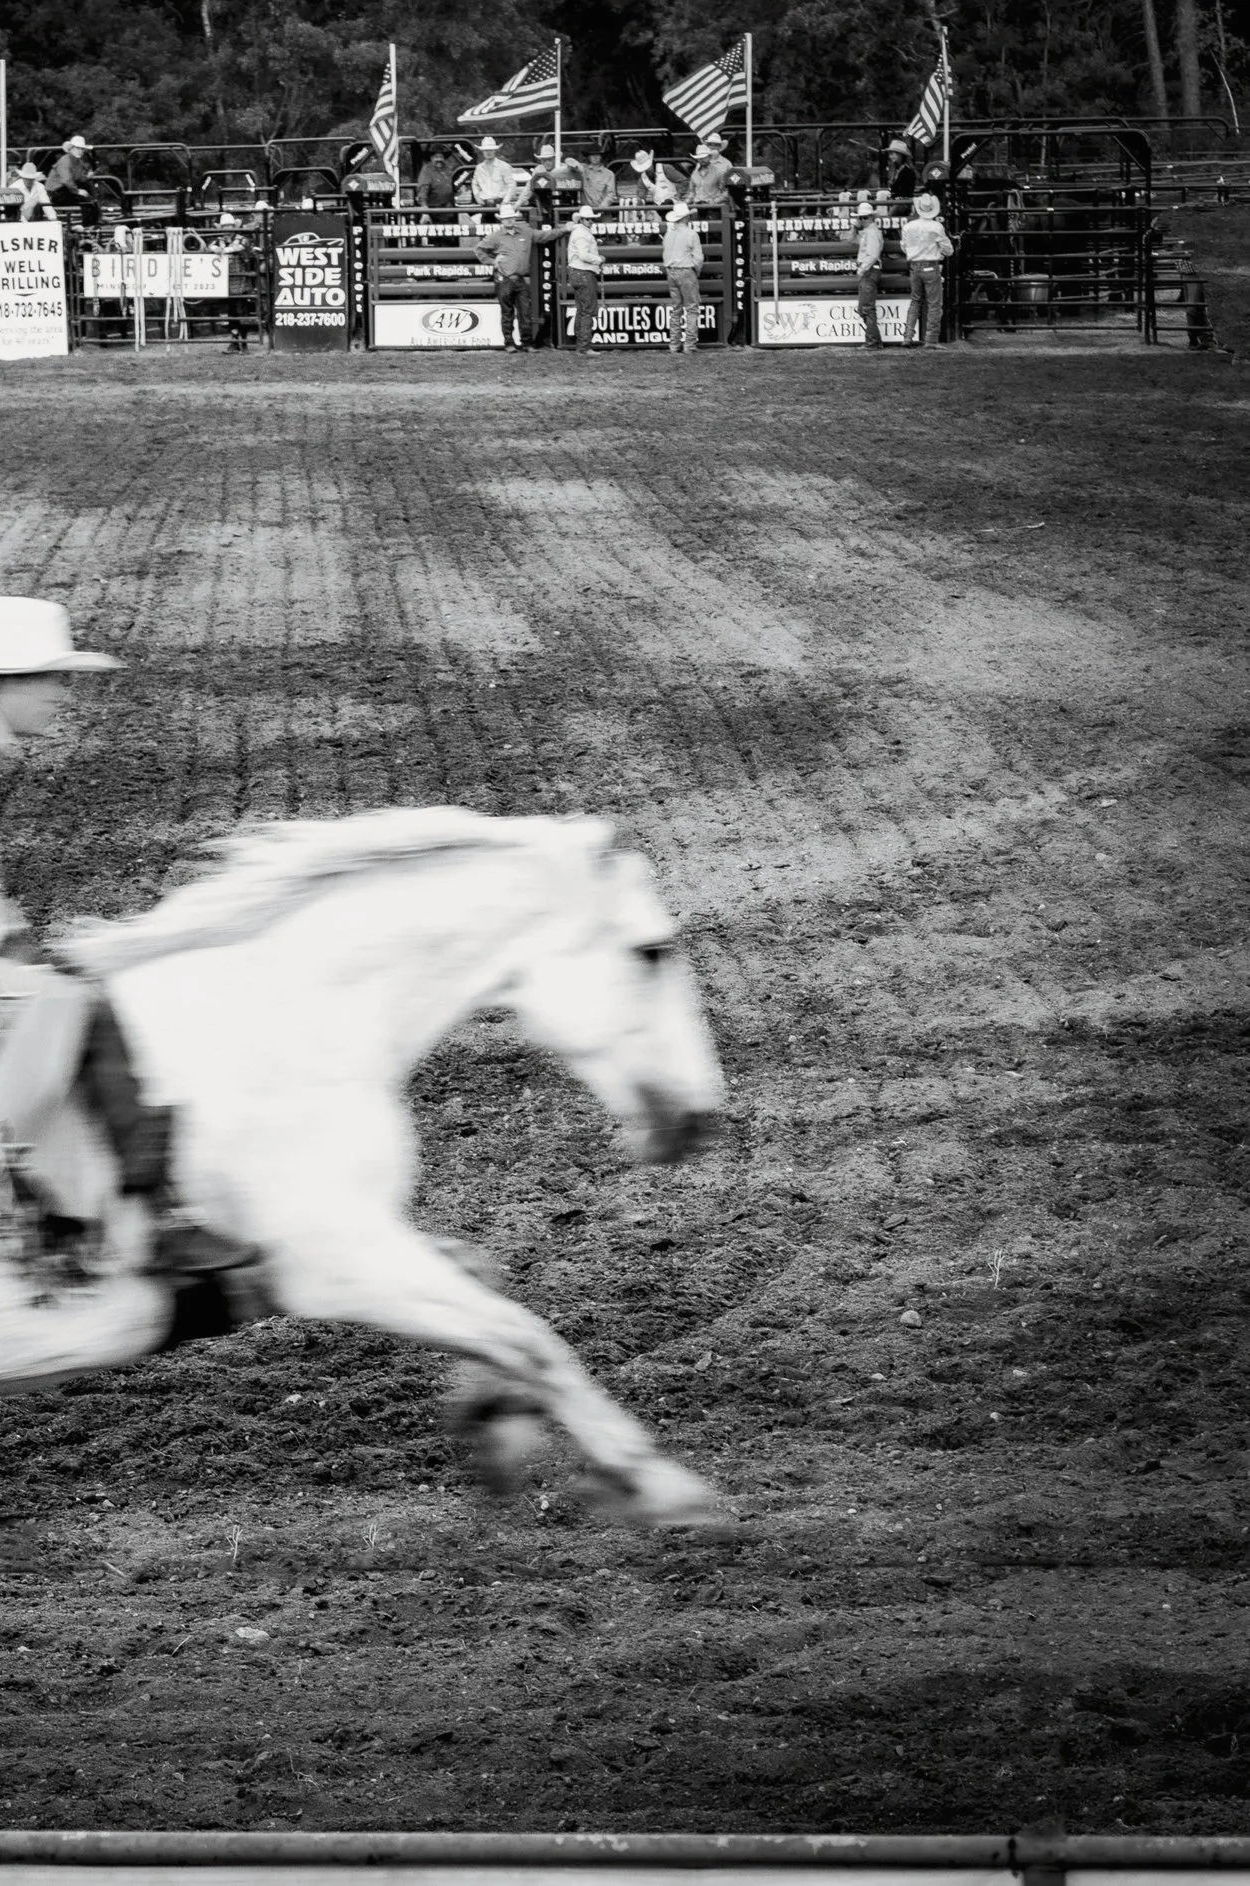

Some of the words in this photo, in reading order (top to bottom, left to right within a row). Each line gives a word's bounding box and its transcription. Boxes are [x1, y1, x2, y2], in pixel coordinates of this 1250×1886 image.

[382, 224, 470, 236] HEADWATERS
[275, 247, 344, 266] WEST
[4, 260, 45, 273] WELL
[406, 265, 430, 276] Park
[475, 265, 493, 275] MN
[541, 224, 552, 312] Piefert
[602, 263, 620, 274] ark
[791, 261, 816, 271] Park
[278, 267, 342, 286] SIDE
[274, 287, 346, 306] AUTO
[829, 305, 900, 320] CUSOM
[816, 322, 907, 338] CABINTR
[591, 332, 629, 343] AND
